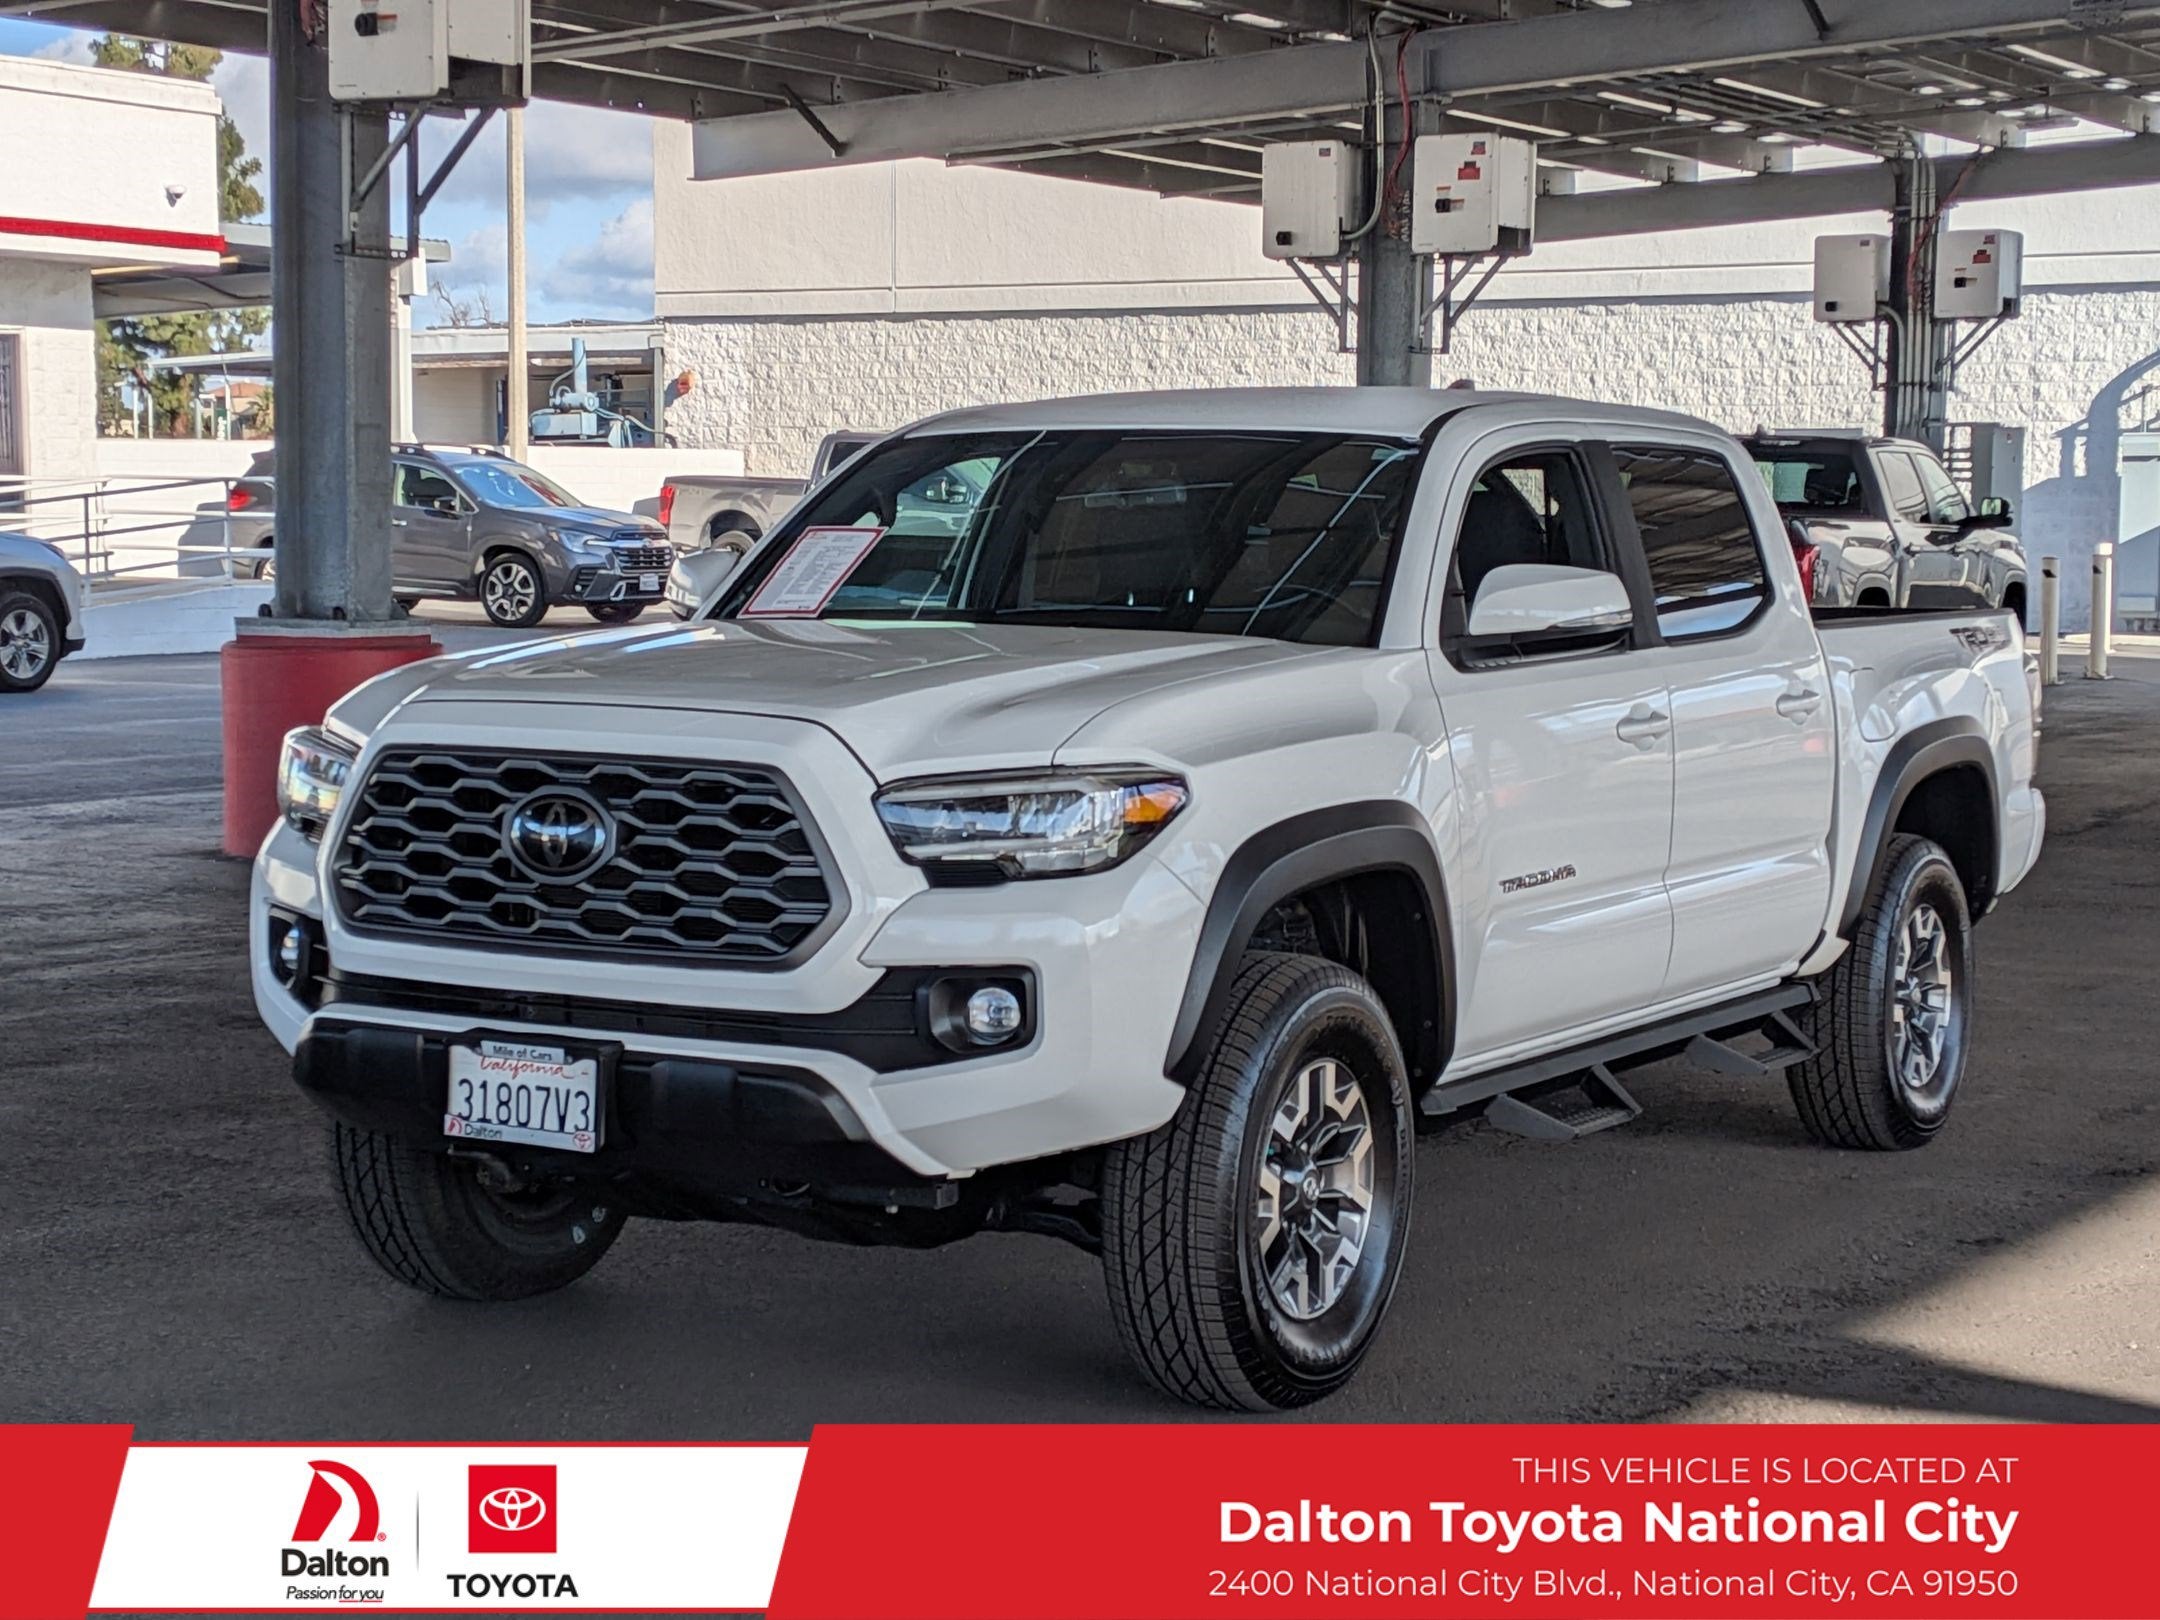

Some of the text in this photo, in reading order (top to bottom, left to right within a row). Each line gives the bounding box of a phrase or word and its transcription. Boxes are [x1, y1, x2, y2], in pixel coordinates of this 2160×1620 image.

[492, 1044, 553, 1061] Mile of Cars
[480, 1056, 575, 1080] California
[458, 1078, 591, 1134] 31807V3
[464, 1124, 503, 1139] Dalton
